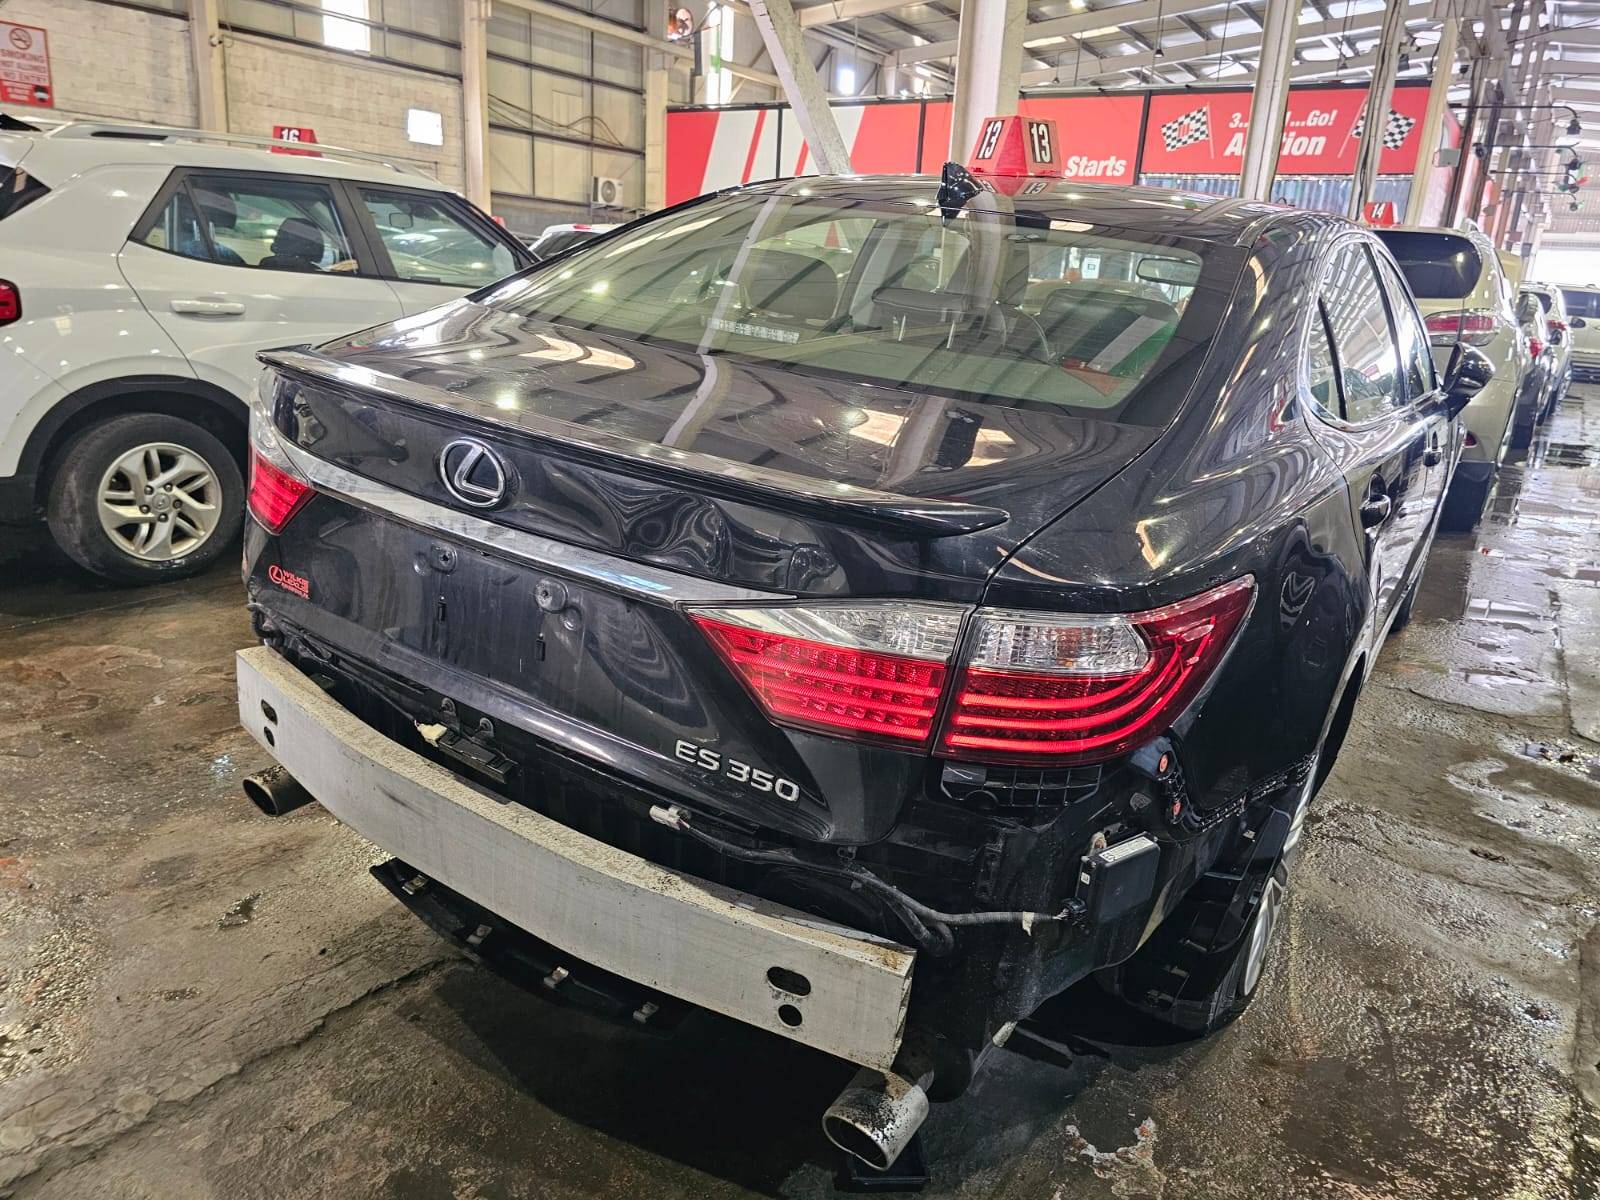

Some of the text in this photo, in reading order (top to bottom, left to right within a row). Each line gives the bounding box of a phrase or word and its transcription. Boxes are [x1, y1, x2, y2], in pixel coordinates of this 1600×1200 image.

[281, 128, 300, 142] 16
[977, 120, 1002, 159] 13
[1031, 123, 1051, 163] 13
[1223, 131, 1326, 156] Ation
[1064, 155, 1127, 177] Starts
[1371, 202, 1386, 218] 14
[675, 739, 799, 802] ES 350
